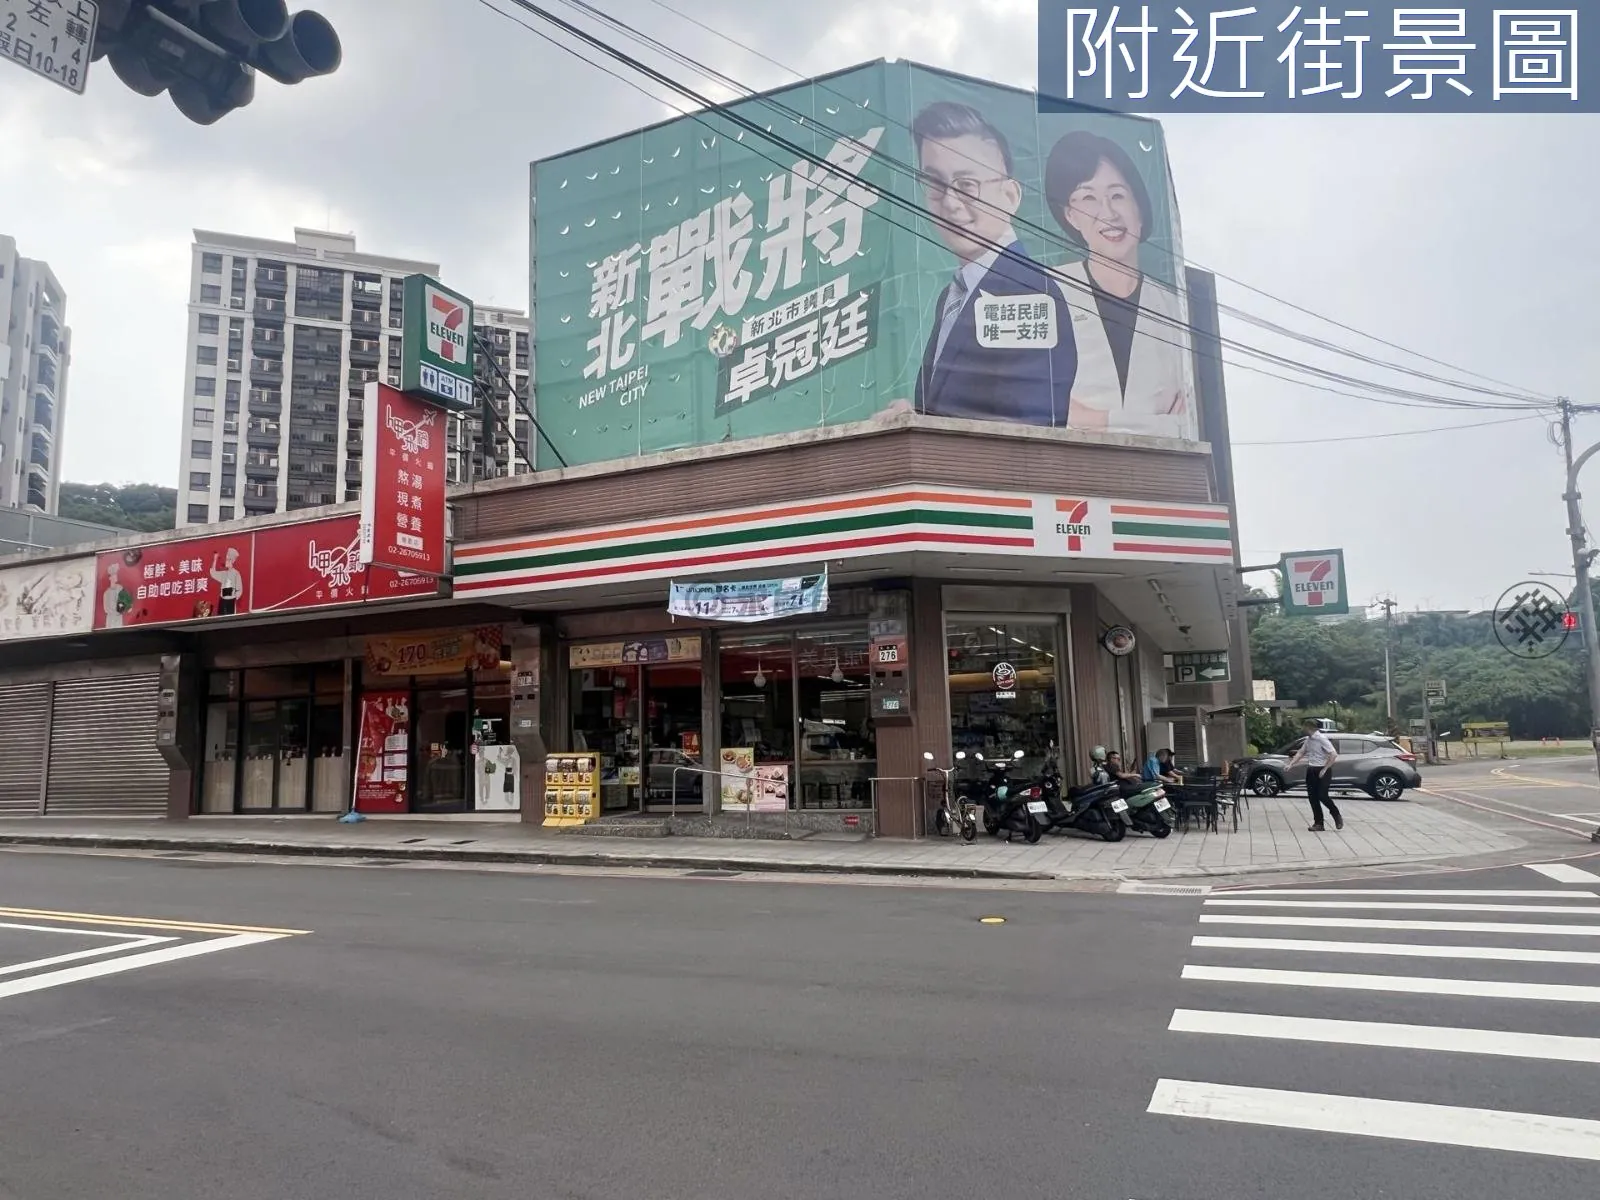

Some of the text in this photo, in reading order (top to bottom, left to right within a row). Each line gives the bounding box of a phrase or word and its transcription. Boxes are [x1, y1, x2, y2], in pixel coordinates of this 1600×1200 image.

[641, 127, 885, 348] 戰將
[583, 243, 642, 380] 新北
[750, 283, 836, 336] 新北市議員
[983, 302, 1048, 321] 電話民調
[983, 322, 1048, 341] 唯一支持
[724, 297, 869, 403] 卓冠廷
[579, 364, 648, 410] NEW TAIPEI
[620, 382, 648, 406] CITY
[397, 491, 422, 511] 現煮
[396, 512, 422, 532] 營養
[143, 558, 203, 579] 極鮮、美味
[137, 578, 208, 599] 自助吧吃到爽
[880, 651, 896, 661] 276
